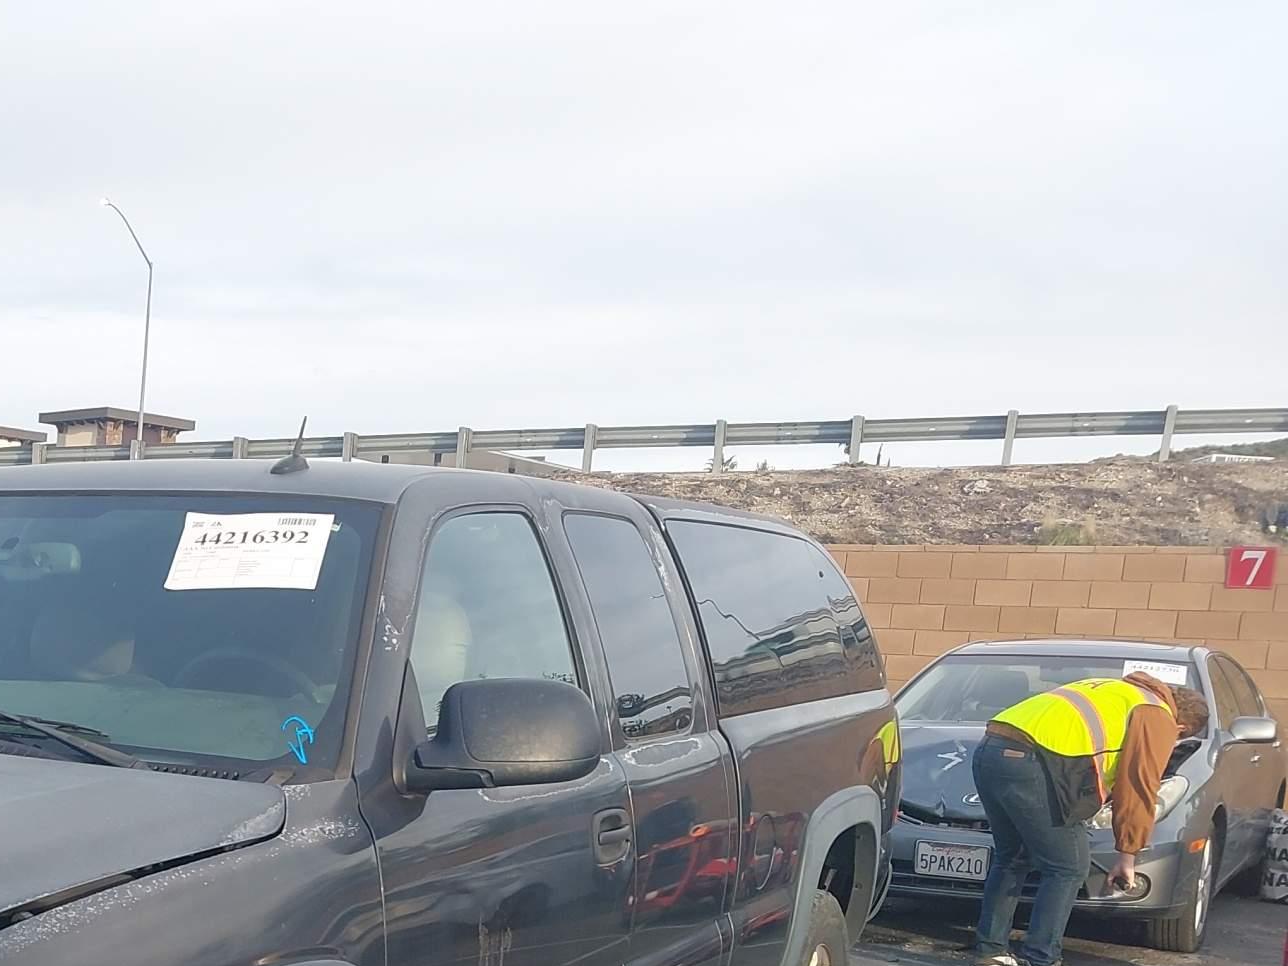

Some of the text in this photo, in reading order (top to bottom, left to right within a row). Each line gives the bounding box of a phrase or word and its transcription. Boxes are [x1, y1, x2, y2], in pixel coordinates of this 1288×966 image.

[194, 530, 310, 546] 44216392
[1240, 550, 1268, 586] 7
[920, 853, 983, 875] 5PAK210
